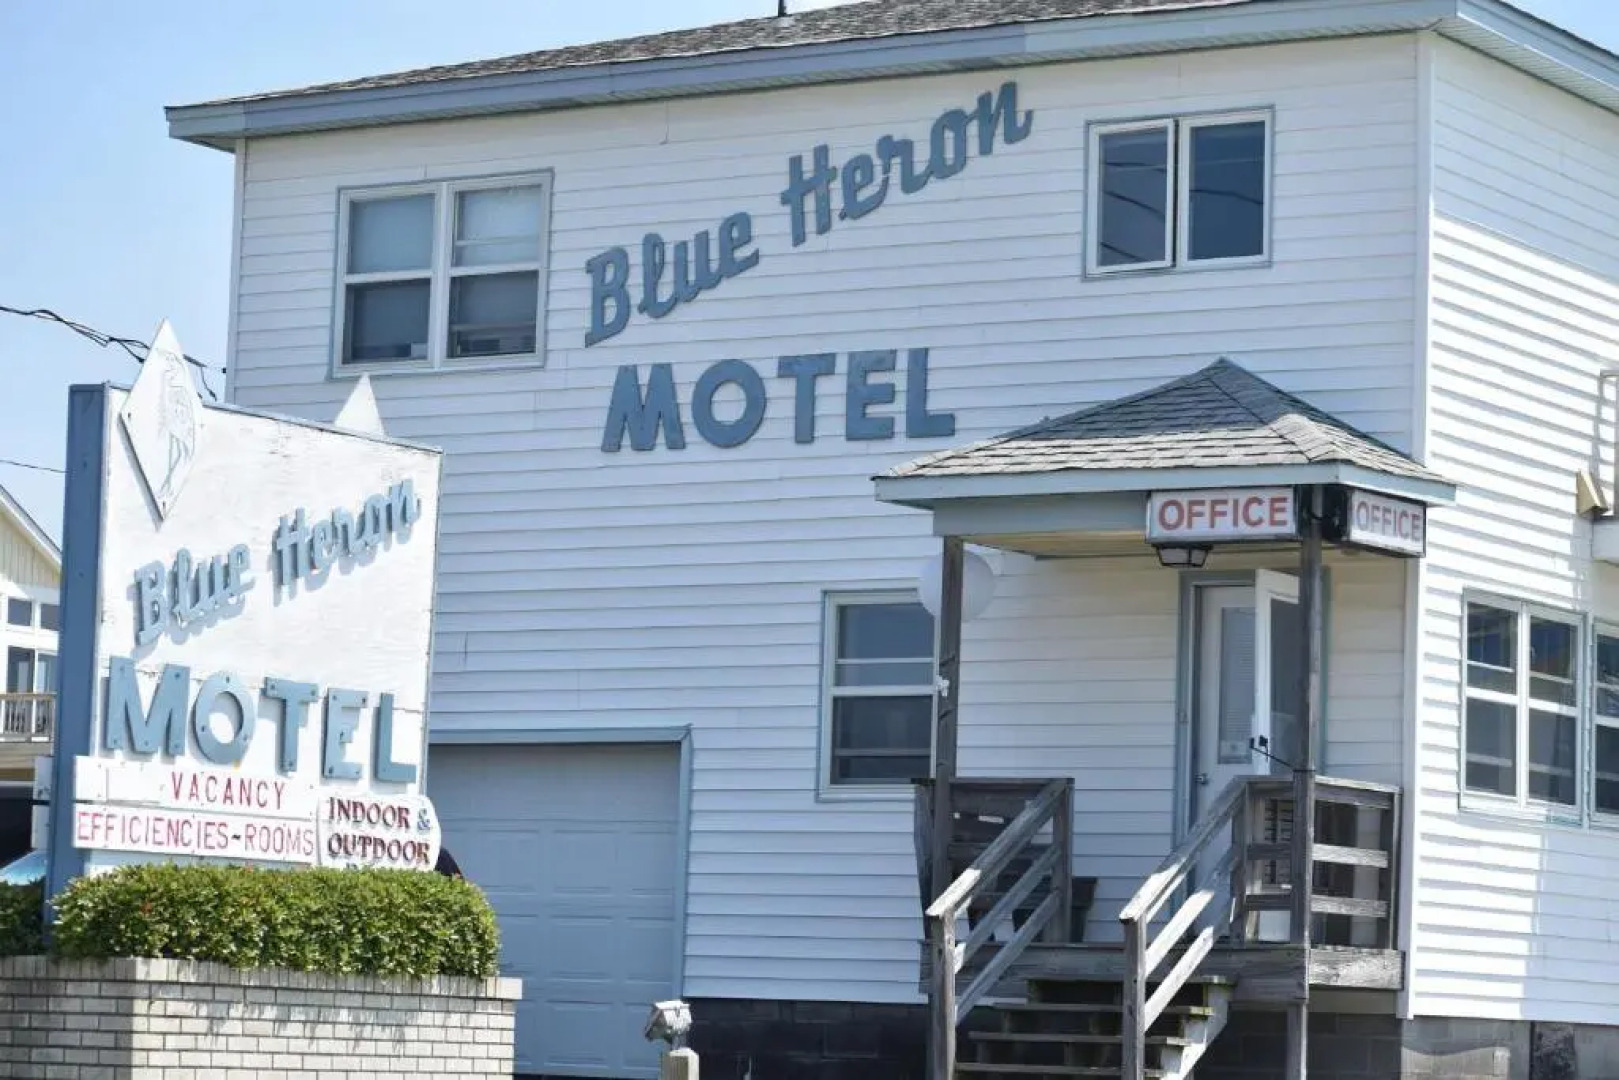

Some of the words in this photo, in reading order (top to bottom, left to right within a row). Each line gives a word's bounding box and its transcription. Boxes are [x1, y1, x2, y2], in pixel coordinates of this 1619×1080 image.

[585, 211, 759, 348] Blue
[780, 81, 1033, 247] Heron
[601, 348, 956, 452] MOTEL
[1158, 495, 1288, 531] OFFICE
[1355, 500, 1421, 543] OFFICE
[132, 543, 252, 648] Blue
[272, 478, 421, 592] Heron
[105, 656, 417, 784] MOTEL
[170, 770, 286, 811] VACANCY
[328, 796, 410, 829] INDOOR
[417, 808, 431, 831] &
[327, 831, 431, 866] OUTDOOR
